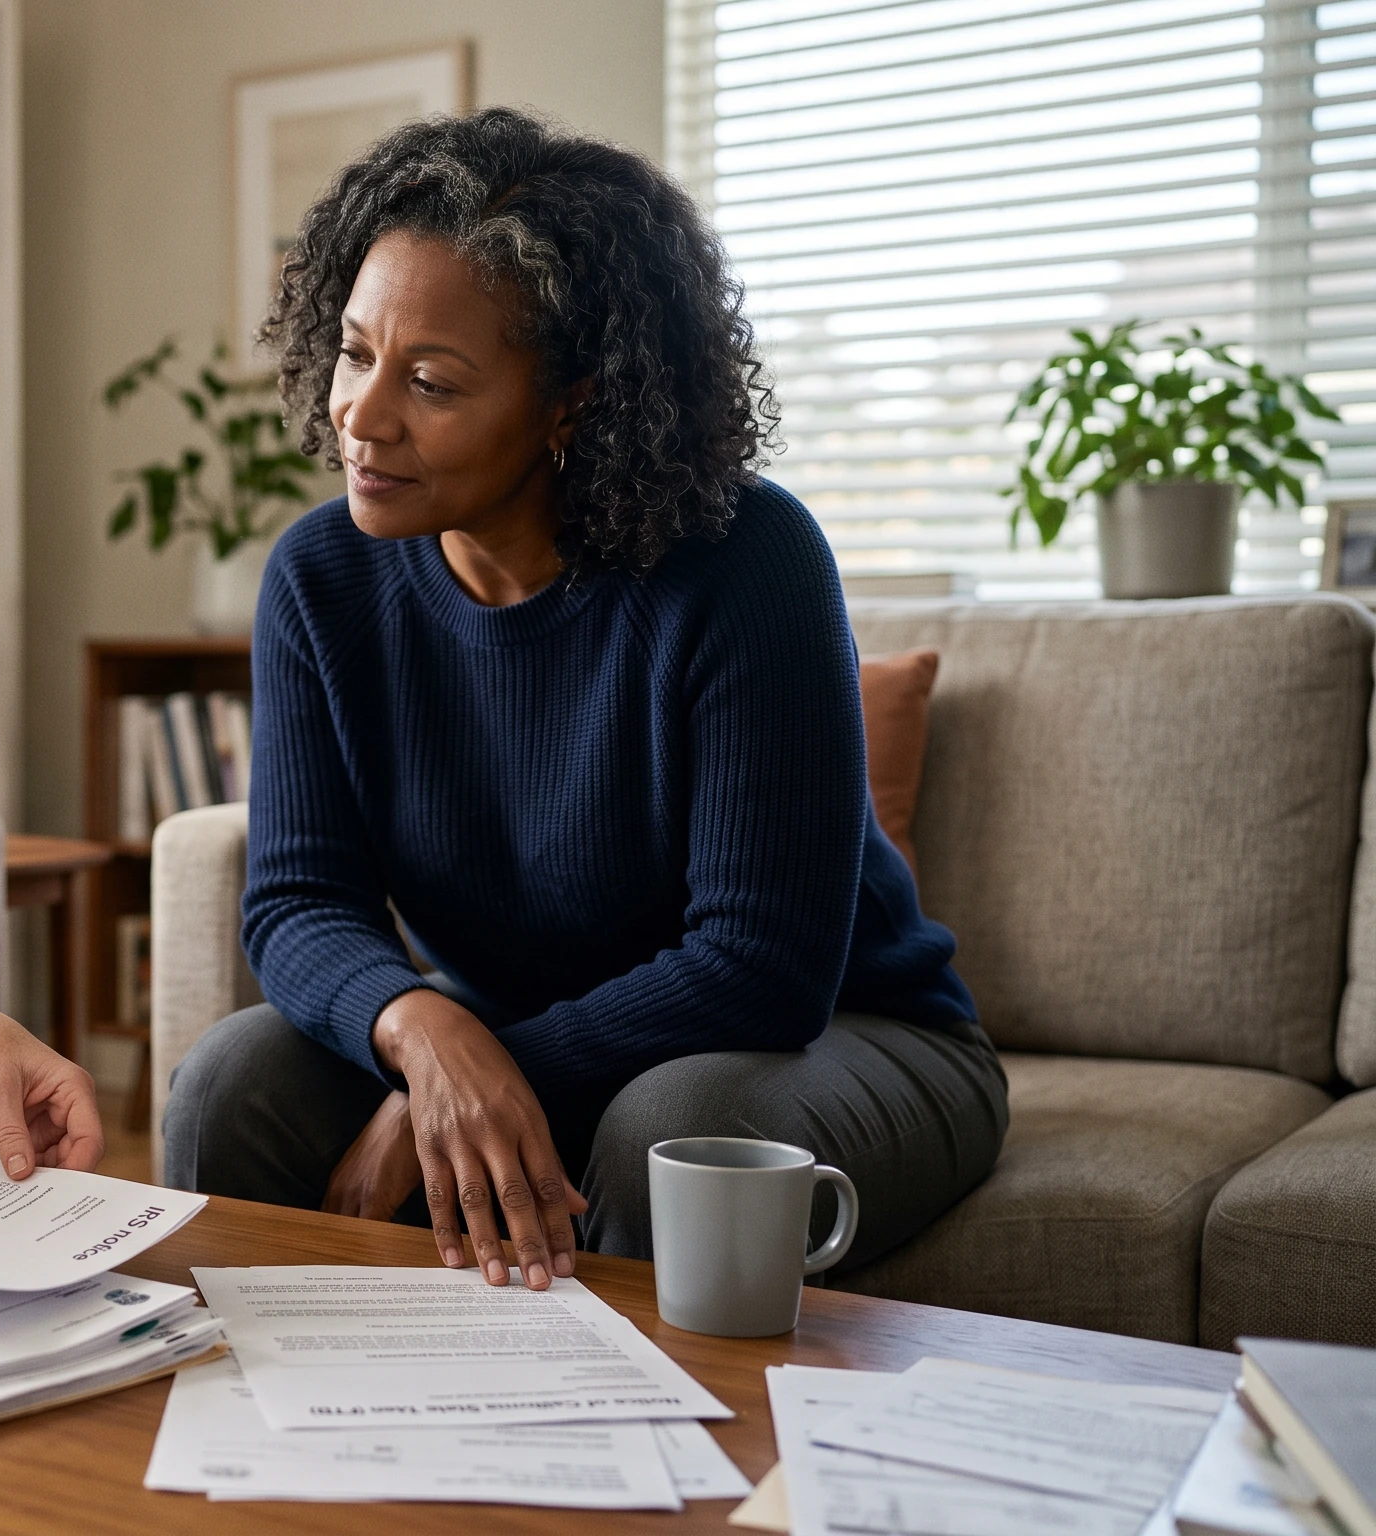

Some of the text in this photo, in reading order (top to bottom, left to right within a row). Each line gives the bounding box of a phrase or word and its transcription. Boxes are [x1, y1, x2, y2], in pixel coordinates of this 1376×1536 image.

[127, 1206, 166, 1228] IRS
[72, 1230, 132, 1261] notice
[485, 1400, 581, 1411] California
[587, 1399, 607, 1408] of
[613, 1397, 682, 1407] Notice
[425, 1403, 481, 1414] State
